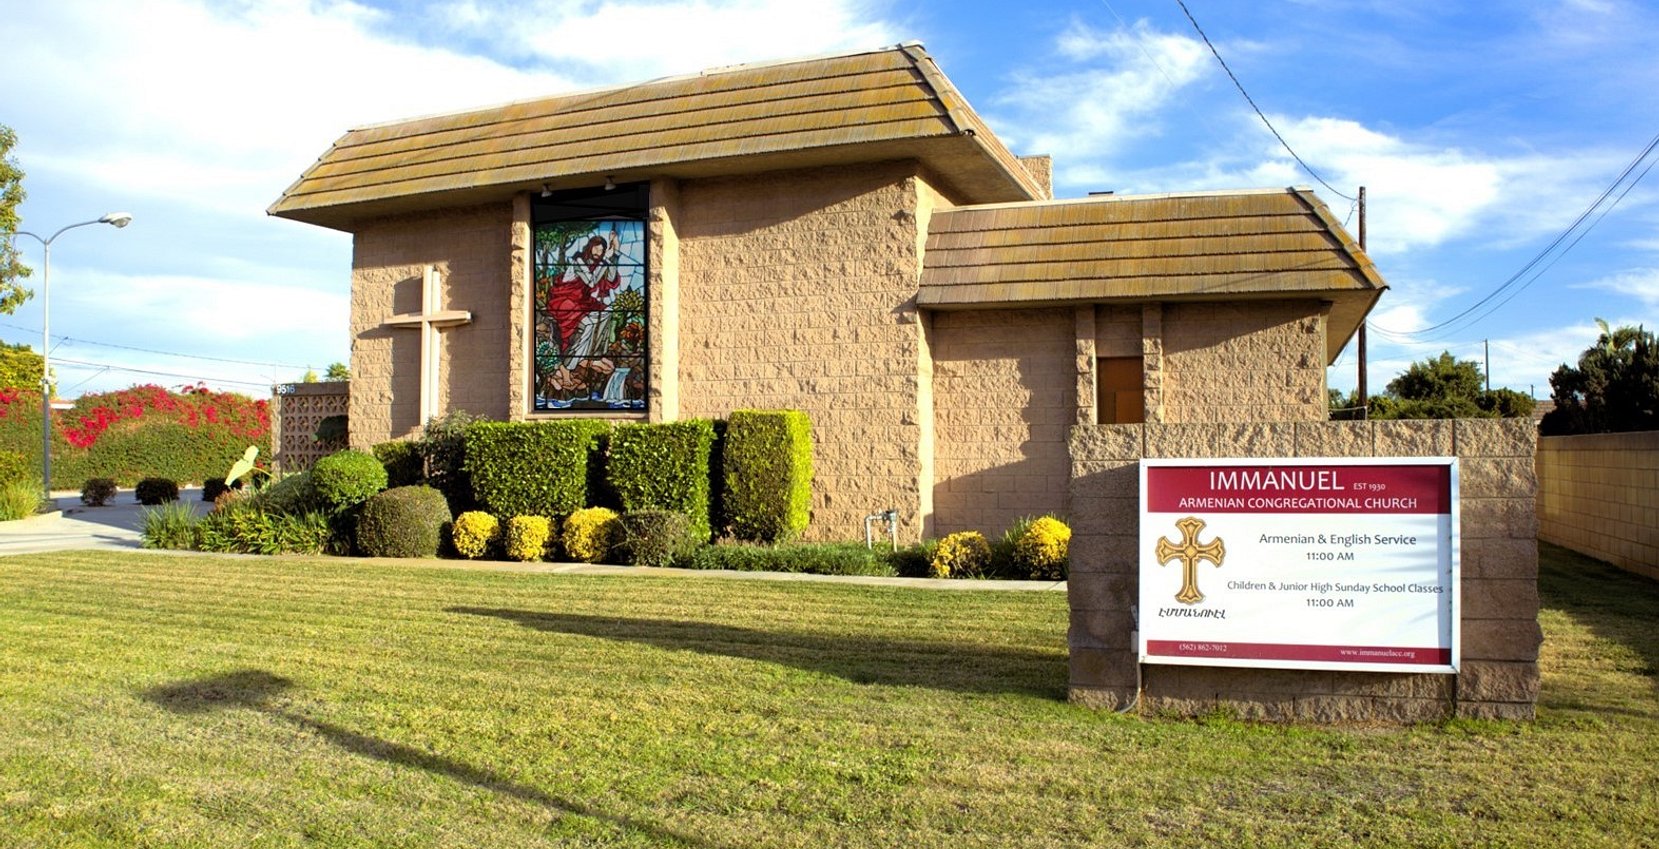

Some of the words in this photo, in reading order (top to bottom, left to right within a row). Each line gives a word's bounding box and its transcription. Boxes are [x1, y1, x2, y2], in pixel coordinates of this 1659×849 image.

[1210, 471, 1345, 490] IMMANUEL
[1369, 483, 1386, 492] 1930
[1179, 498, 1245, 508] ARMENIAN
[1248, 498, 1361, 509] CONGREGATIONAL
[1364, 498, 1417, 509] CHURCH
[1259, 534, 1315, 544] Armenian
[1317, 535, 1327, 544] &
[1330, 534, 1371, 547] English
[1374, 535, 1417, 545] Service
[1306, 552, 1334, 560] 11:00
[1337, 552, 1355, 560] AM
[1227, 580, 1266, 590] Children
[1268, 581, 1276, 590] &
[1278, 582, 1308, 591] Junior
[1310, 582, 1333, 593] High
[1335, 583, 1370, 594] Sunday
[1372, 583, 1405, 593] School
[1408, 584, 1444, 593] Classes
[1306, 598, 1334, 607] 11:00
[1336, 598, 1354, 607] AM
[1198, 644, 1227, 652] 862-7012
[1340, 648, 1415, 658] www.immanuelacc.org
